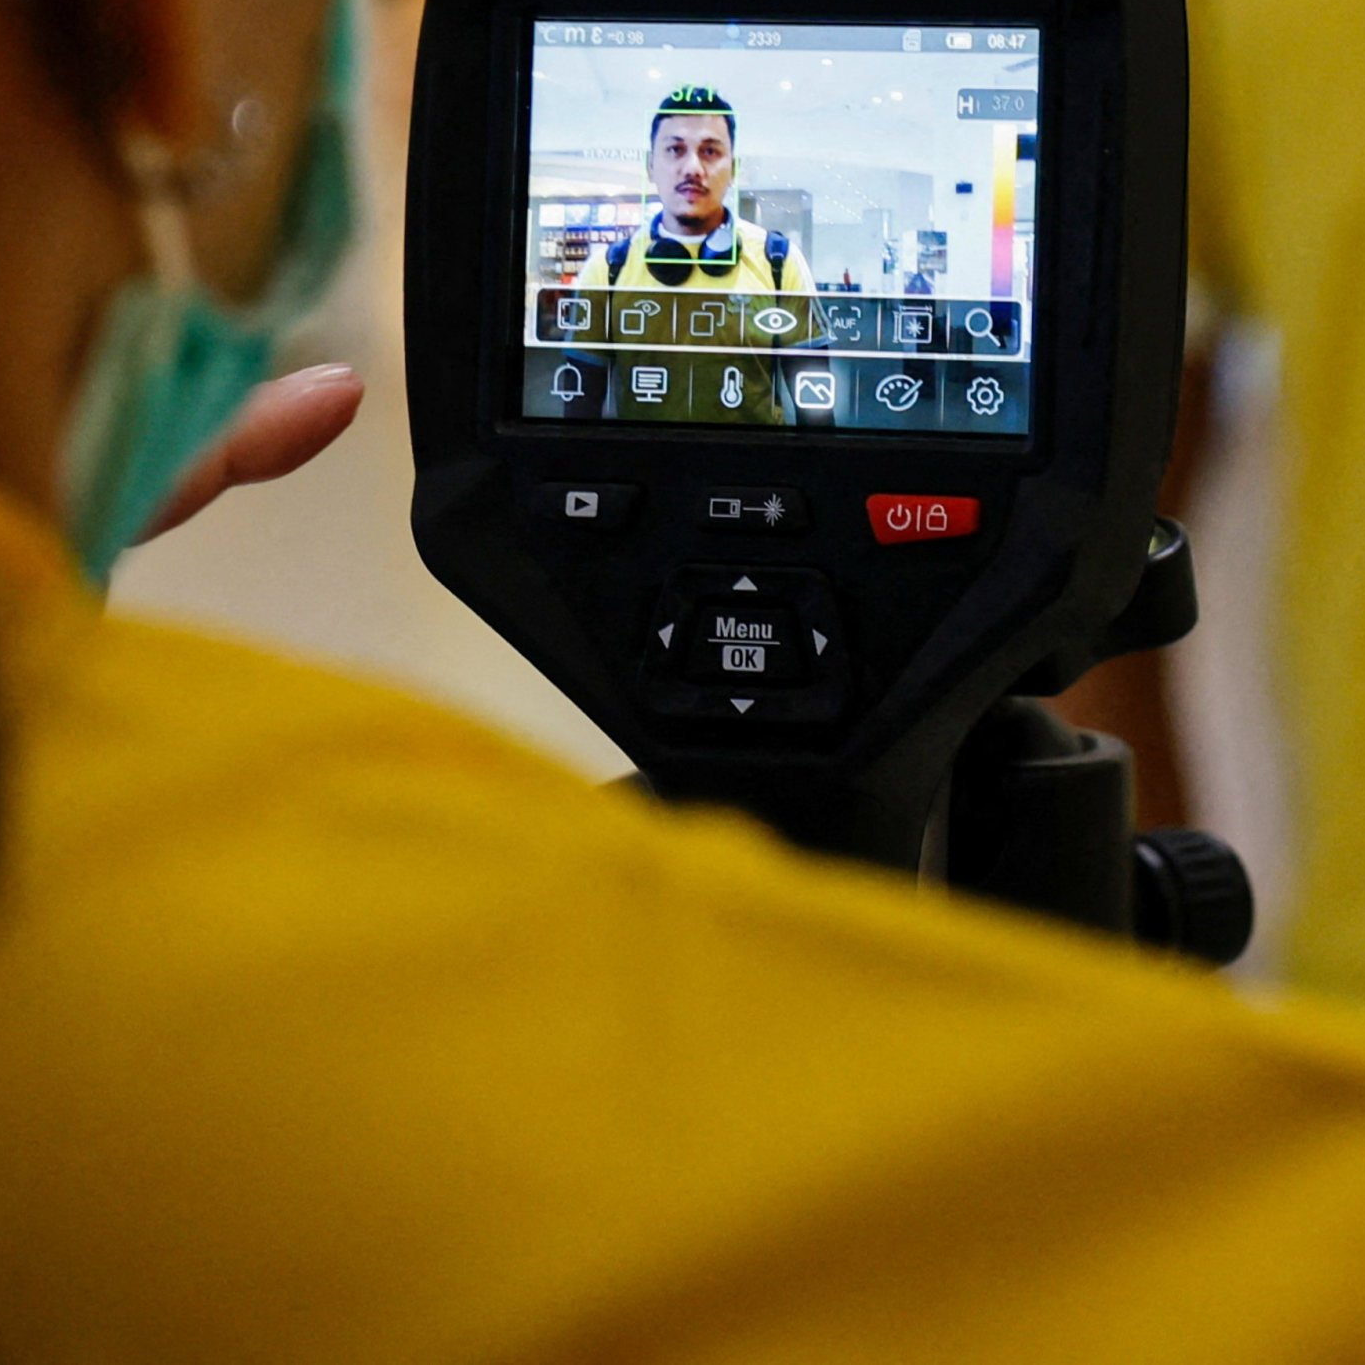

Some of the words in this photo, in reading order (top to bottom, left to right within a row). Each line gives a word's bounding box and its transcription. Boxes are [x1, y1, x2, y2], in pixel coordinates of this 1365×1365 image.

[987, 33, 1026, 49] 08:47
[715, 616, 773, 639] Menu
[730, 648, 758, 669] OK
